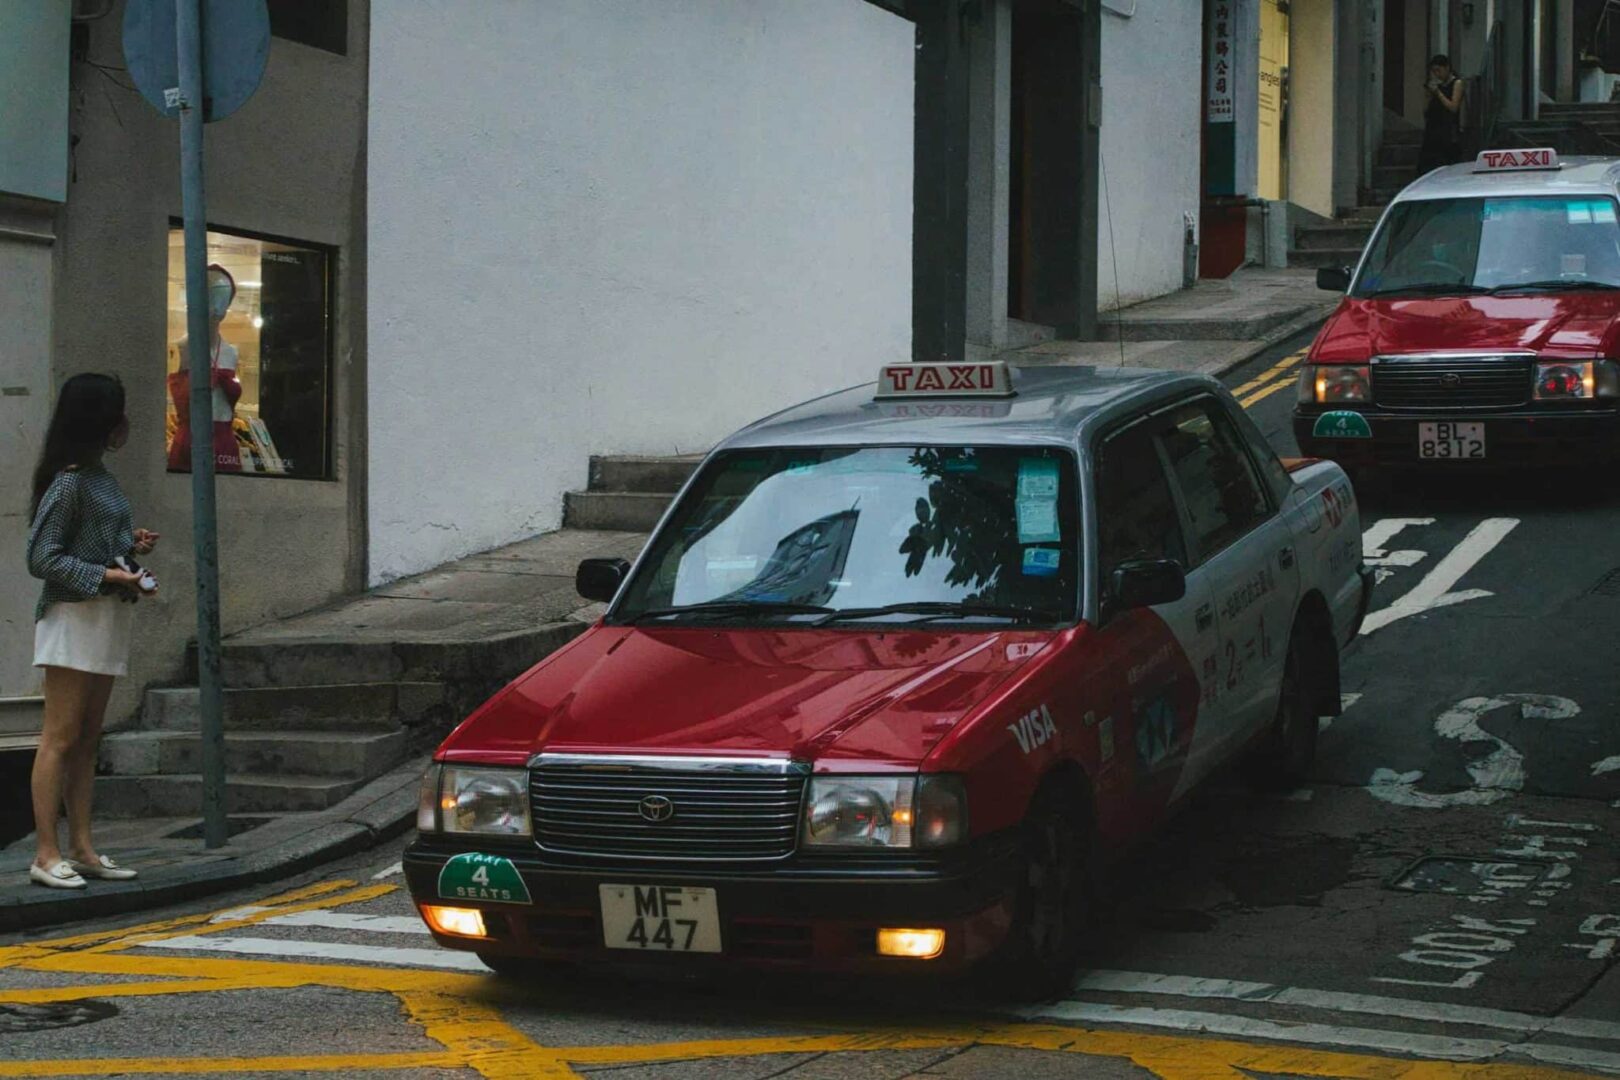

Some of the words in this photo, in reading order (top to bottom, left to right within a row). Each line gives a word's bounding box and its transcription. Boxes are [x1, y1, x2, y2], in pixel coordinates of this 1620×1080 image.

[1483, 149, 1550, 167] TAXI
[886, 365, 994, 391] TAXI
[1336, 417, 1347, 429] 4
[1437, 423, 1467, 440] BL
[1422, 441, 1484, 458] 8312
[1006, 703, 1057, 754] VISA
[464, 854, 502, 866] TAXI
[471, 865, 490, 886] 4
[456, 886, 511, 900] SEATS
[633, 886, 682, 918] MF
[626, 917, 698, 950] 447
[1369, 910, 1537, 988] LOOK
